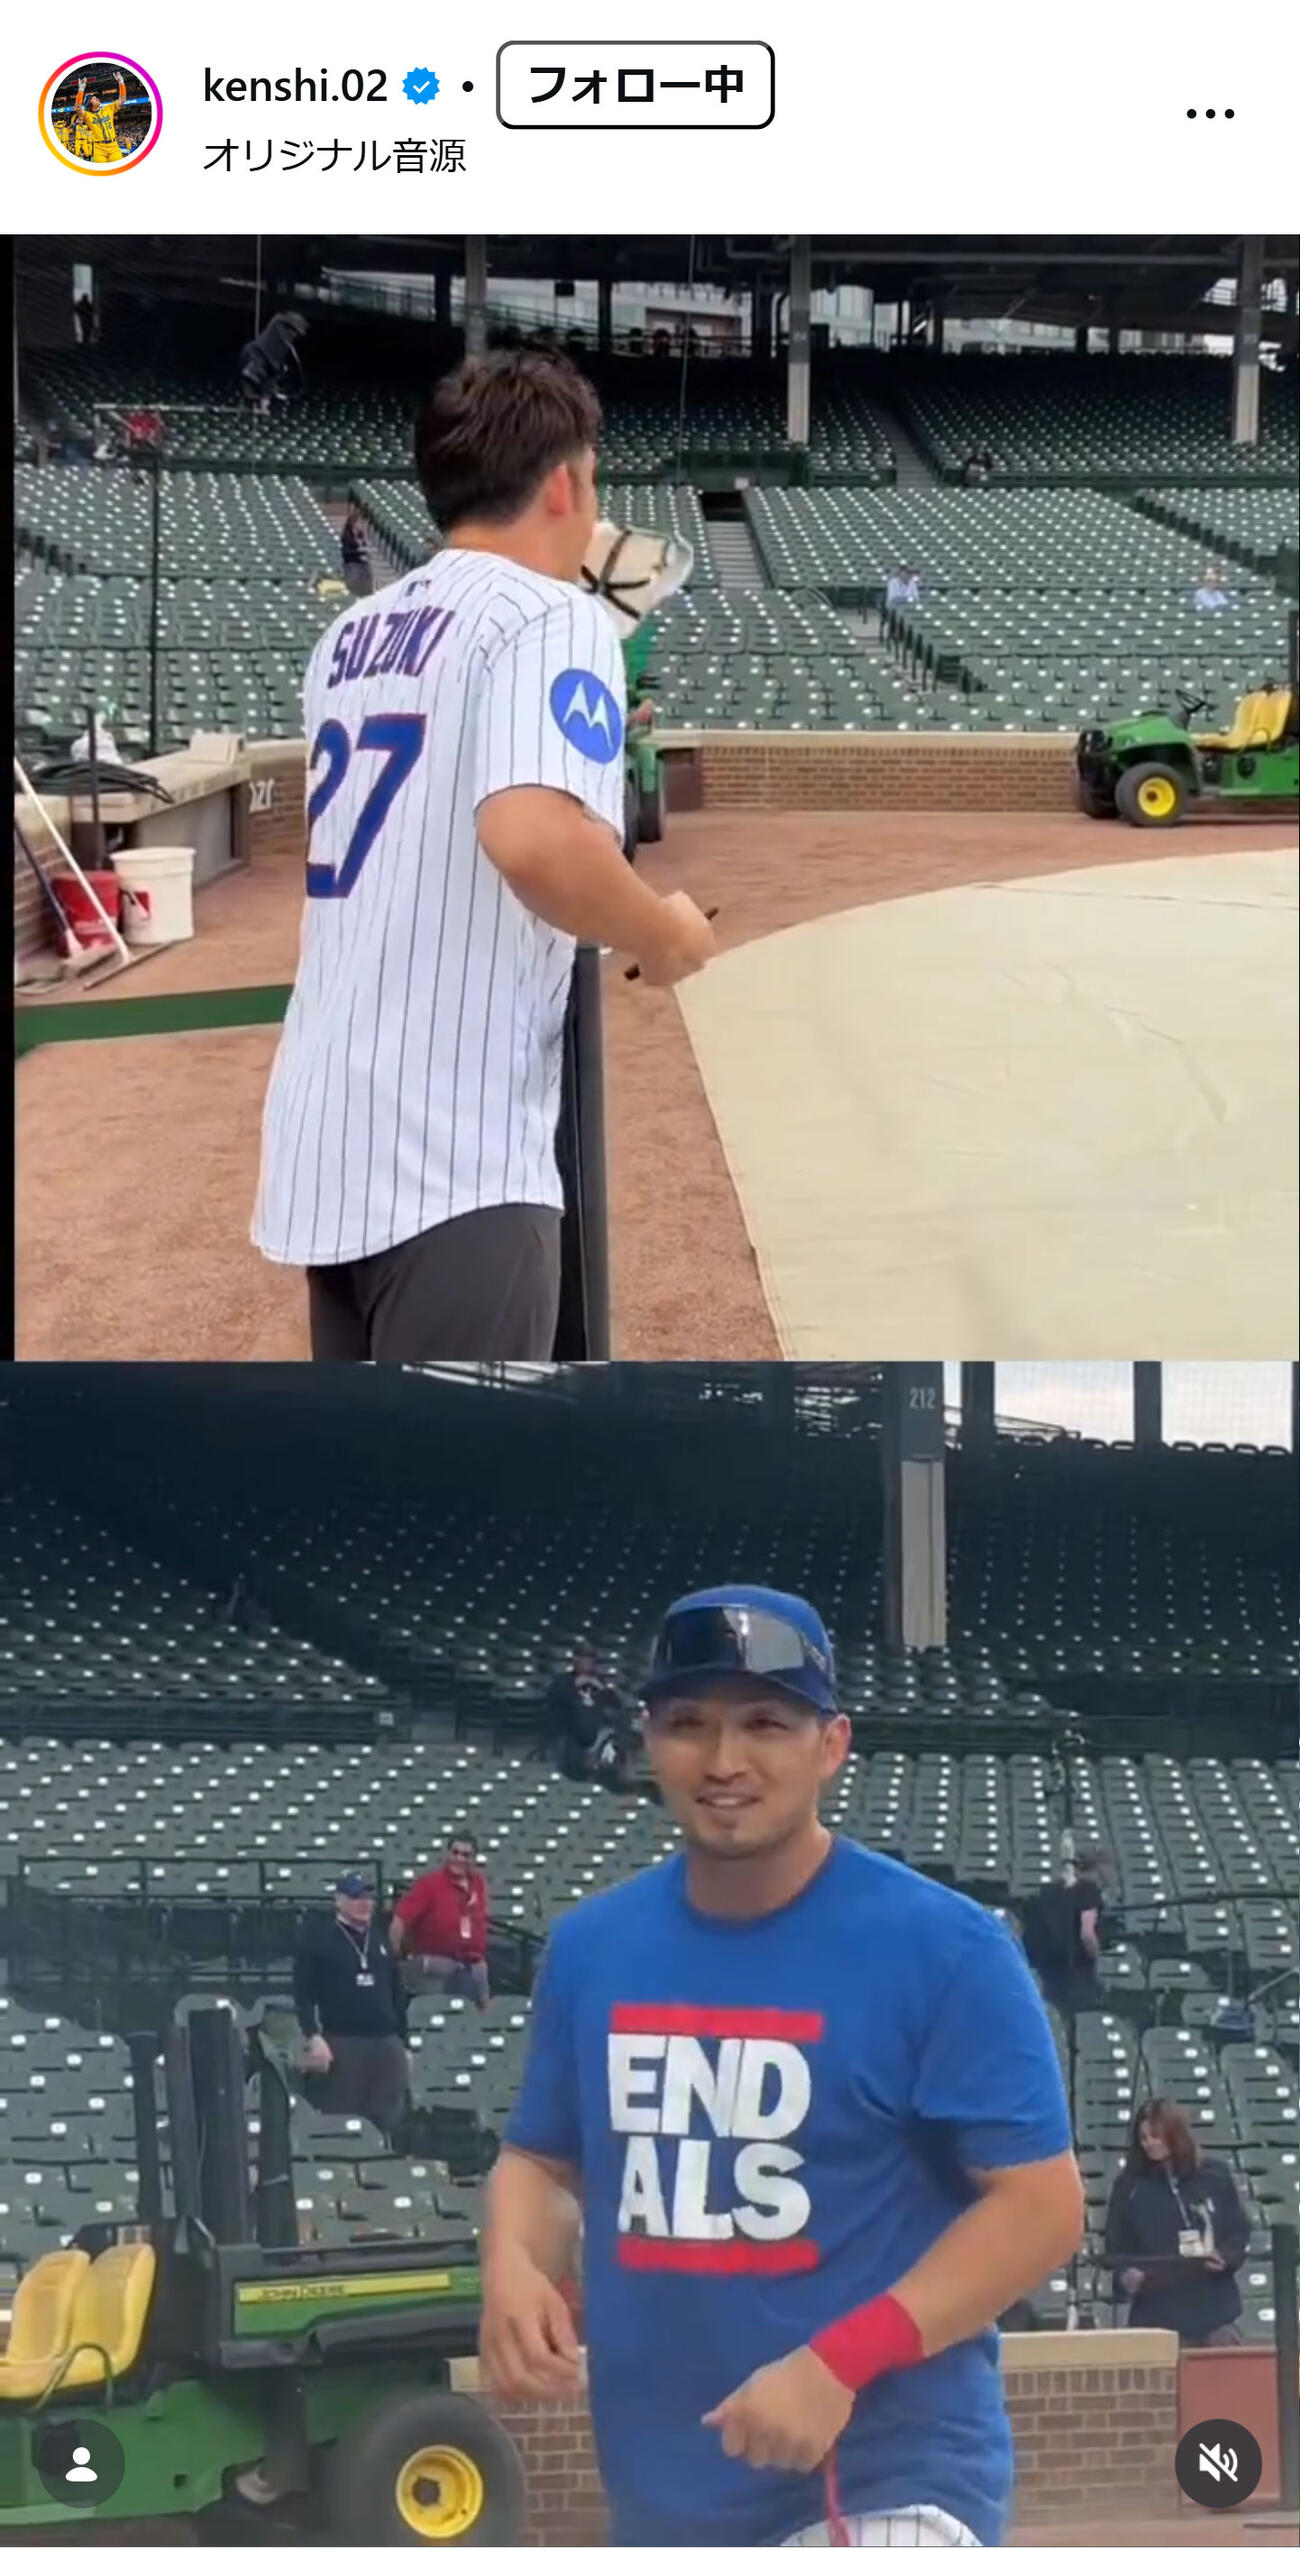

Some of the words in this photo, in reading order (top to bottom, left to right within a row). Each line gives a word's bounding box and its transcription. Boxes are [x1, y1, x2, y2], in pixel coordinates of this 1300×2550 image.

[328, 606, 455, 688] SUZUKI
[306, 713, 427, 898] 27
[910, 1387, 935, 1409] 212
[608, 2032, 811, 2140] END
[618, 2136, 811, 2241] ALS
